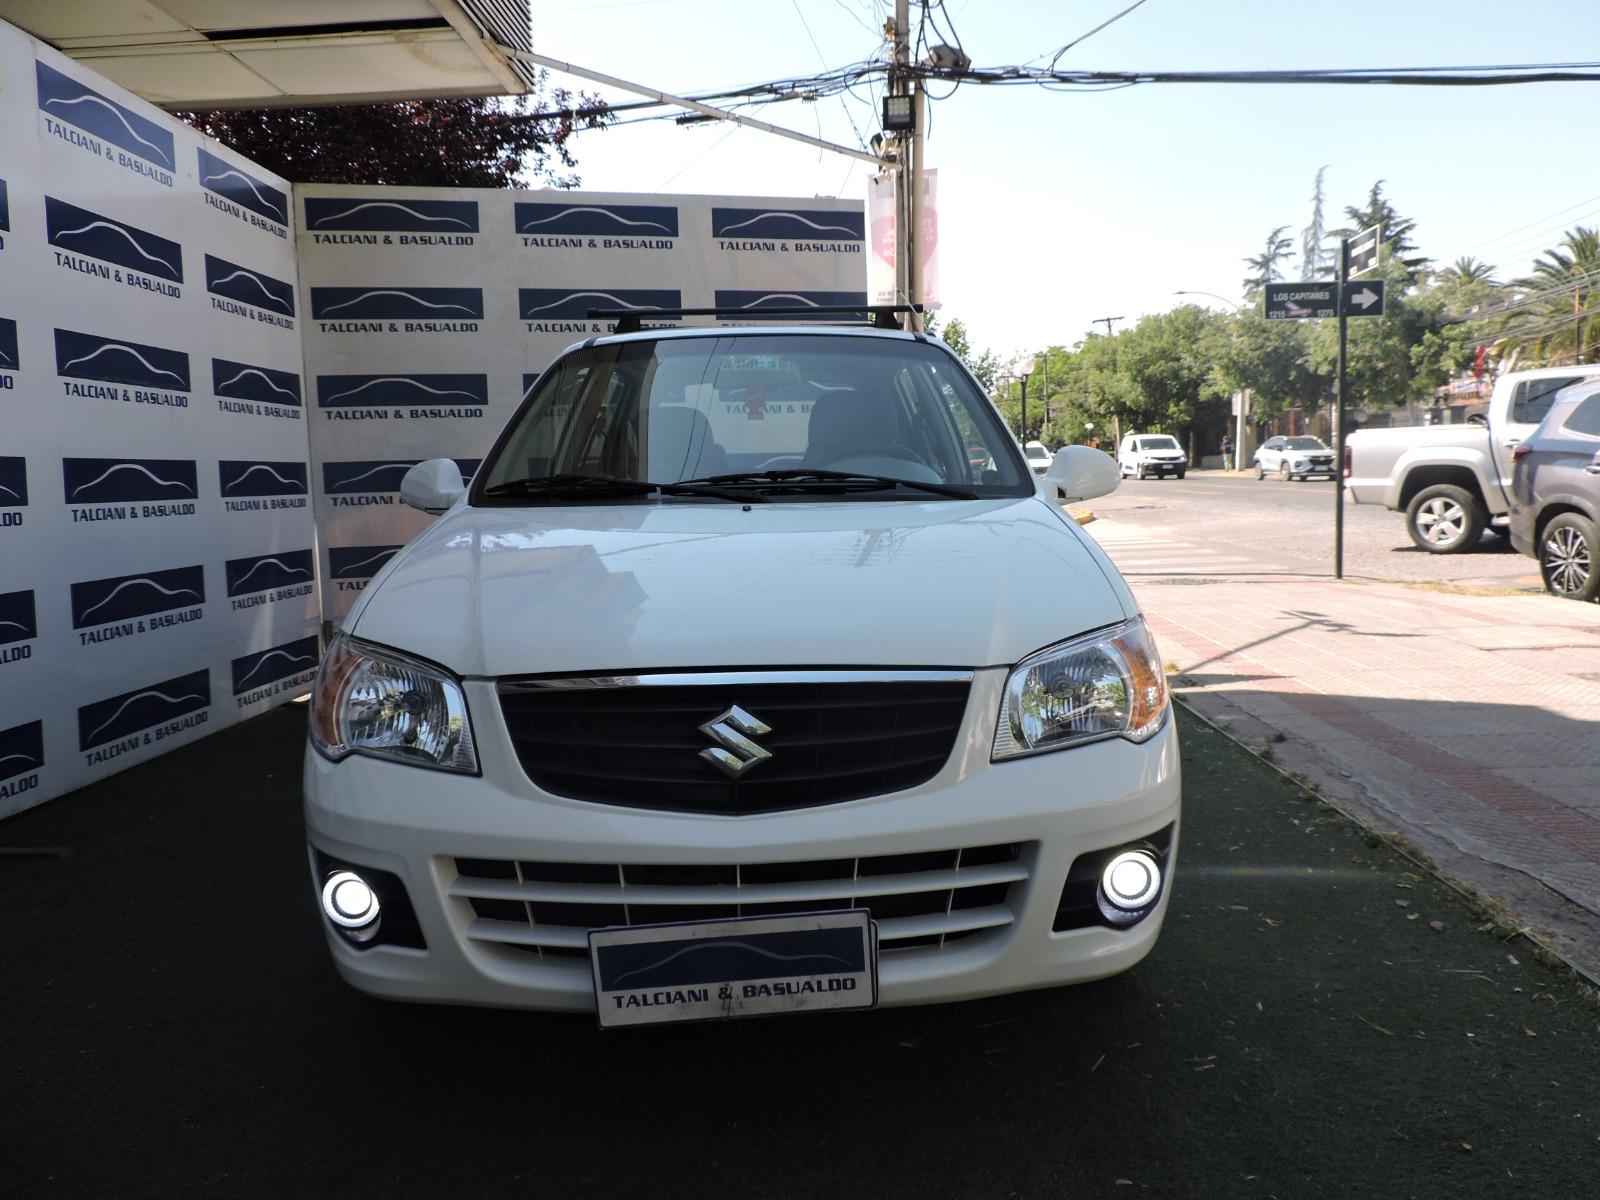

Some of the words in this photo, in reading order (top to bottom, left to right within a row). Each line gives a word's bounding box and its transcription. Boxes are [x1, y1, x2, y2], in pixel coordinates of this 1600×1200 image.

[45, 119, 101, 156] TALCIANI
[106, 148, 114, 160] &
[119, 153, 172, 188] BASUALDO
[204, 193, 240, 219] TALCIANI
[243, 211, 248, 222] &
[250, 215, 287, 239] BASUALDO
[313, 234, 378, 246] TALCIANI
[384, 235, 393, 246] &
[400, 235, 474, 246] BASUALDO
[523, 238, 582, 248] TALCIANI
[588, 239, 597, 248] &
[604, 240, 674, 250] BASUALDO
[720, 241, 775, 252] TALCIANI
[780, 242, 790, 252] &
[794, 242, 860, 253] BASUALDO
[55, 252, 110, 279] TALCIANI
[114, 269, 122, 282] &
[127, 273, 180, 298] BASUALDO
[1273, 293, 1288, 301] LOS
[1290, 292, 1330, 300] CAPITANES
[211, 298, 246, 316] TALCIANI
[250, 309, 255, 319] &
[258, 311, 294, 330] BASUALDO
[320, 322, 382, 333] TALCIANI
[389, 322, 398, 332] &
[405, 322, 478, 333] BASUALDO
[526, 324, 586, 332] TALCIANI
[592, 324, 600, 332] &
[64, 382, 118, 400] TALCIANI
[122, 389, 130, 401] &
[135, 392, 188, 407] BASUALDO
[218, 400, 254, 414] TALCIANI
[256, 406, 262, 416] &
[265, 407, 300, 418] BASUALDO
[326, 410, 388, 420] TALCIANI
[394, 410, 404, 419] &
[410, 408, 483, 418] BASUALDO
[224, 501, 260, 512] TALCIANI
[263, 500, 268, 510] &
[272, 498, 306, 509] BASUALDO
[331, 496, 392, 506] TALCIANI
[72, 509, 126, 522] TALCIANI
[130, 508, 138, 519] &
[142, 504, 195, 518] BASUALDO
[232, 596, 266, 610] TALCIANI
[269, 593, 274, 602] &
[277, 585, 312, 601] BASUALDO
[80, 624, 133, 646] TALCIANI
[138, 621, 145, 633] &
[150, 608, 202, 631] BASUALDO
[237, 688, 272, 708] TALCIANI
[274, 685, 279, 694] &
[86, 735, 140, 766] TALCIANI
[144, 733, 152, 746] &
[156, 710, 208, 740] BASUALDO
[613, 989, 708, 1008] TALCIANI
[718, 983, 732, 1000] &
[743, 978, 856, 998] BASUALDO
